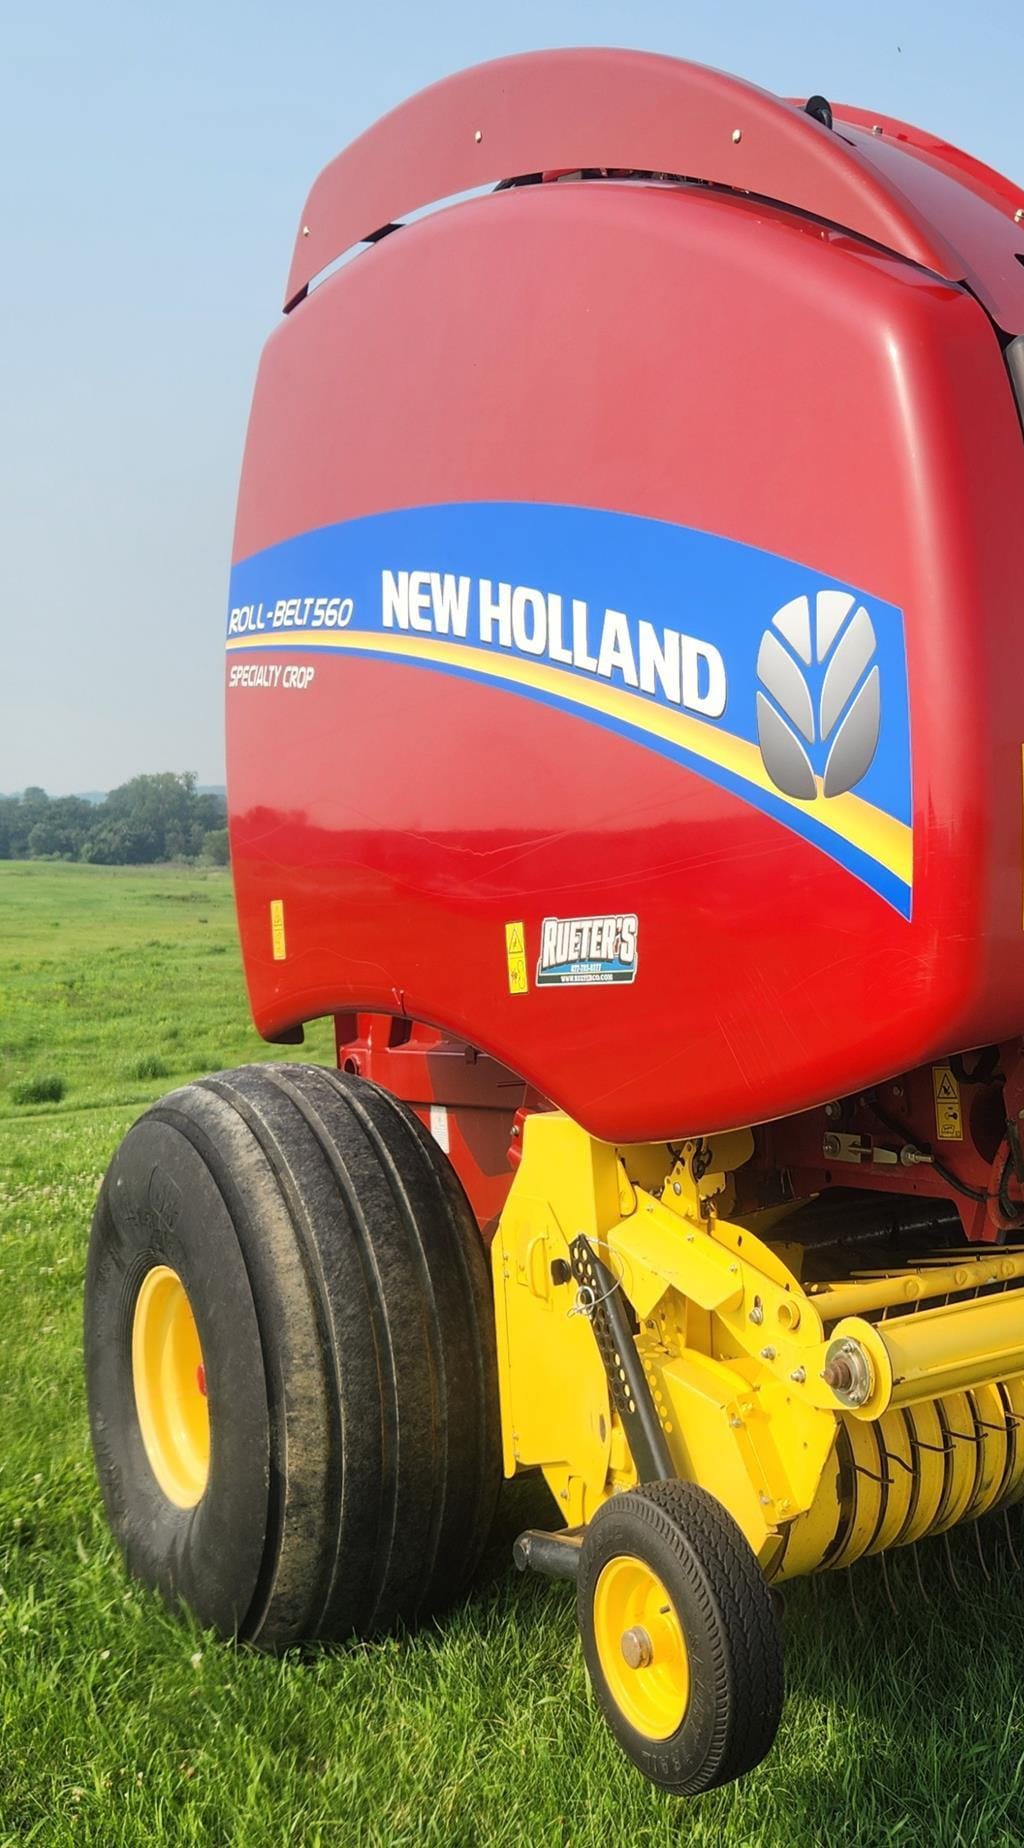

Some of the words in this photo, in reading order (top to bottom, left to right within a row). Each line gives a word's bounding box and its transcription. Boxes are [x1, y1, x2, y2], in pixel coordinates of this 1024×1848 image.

[311, 597, 354, 627] 560
[382, 570, 471, 637] NEW
[479, 578, 728, 719] HOLLAND
[229, 665, 282, 687] SPECIALTY
[282, 666, 315, 688] CROP
[543, 917, 635, 969] RUETER'S
